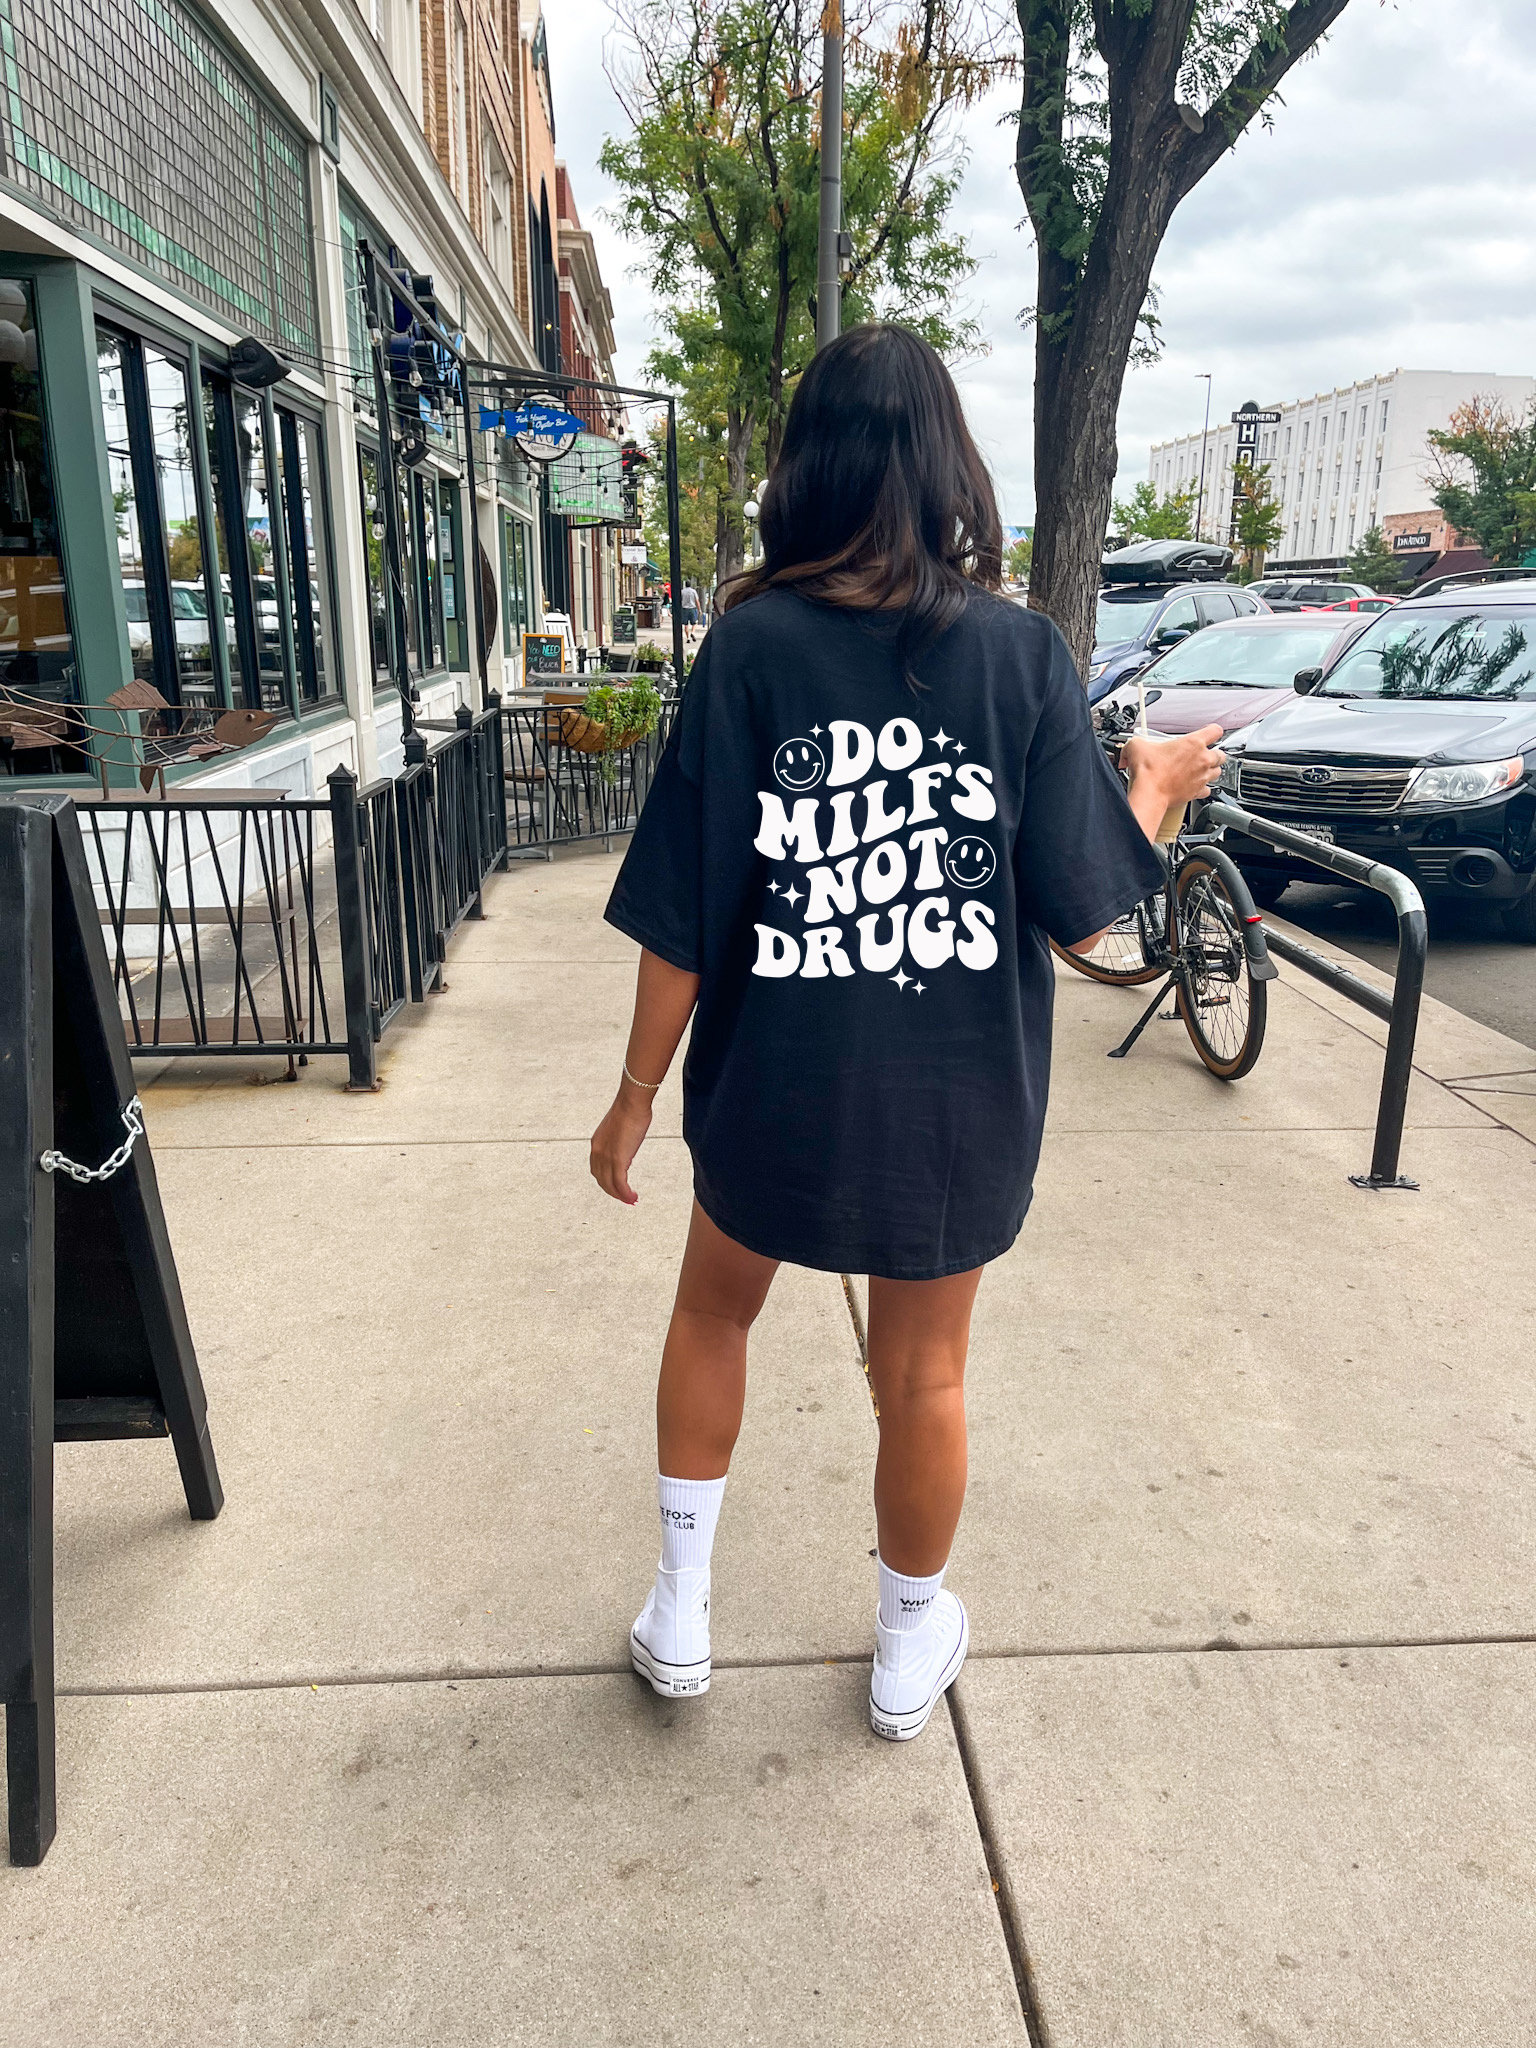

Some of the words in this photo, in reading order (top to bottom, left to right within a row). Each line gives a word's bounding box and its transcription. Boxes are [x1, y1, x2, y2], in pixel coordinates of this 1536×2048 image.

[555, 417, 568, 427] Bar
[1236, 413, 1277, 422] NORTHERN
[542, 645, 561, 654] NEED
[826, 717, 924, 787] DO
[753, 762, 997, 863] MILFS
[803, 826, 949, 924] NOT
[751, 896, 998, 978] DRUGS
[674, 1521, 695, 1530] CLUB
